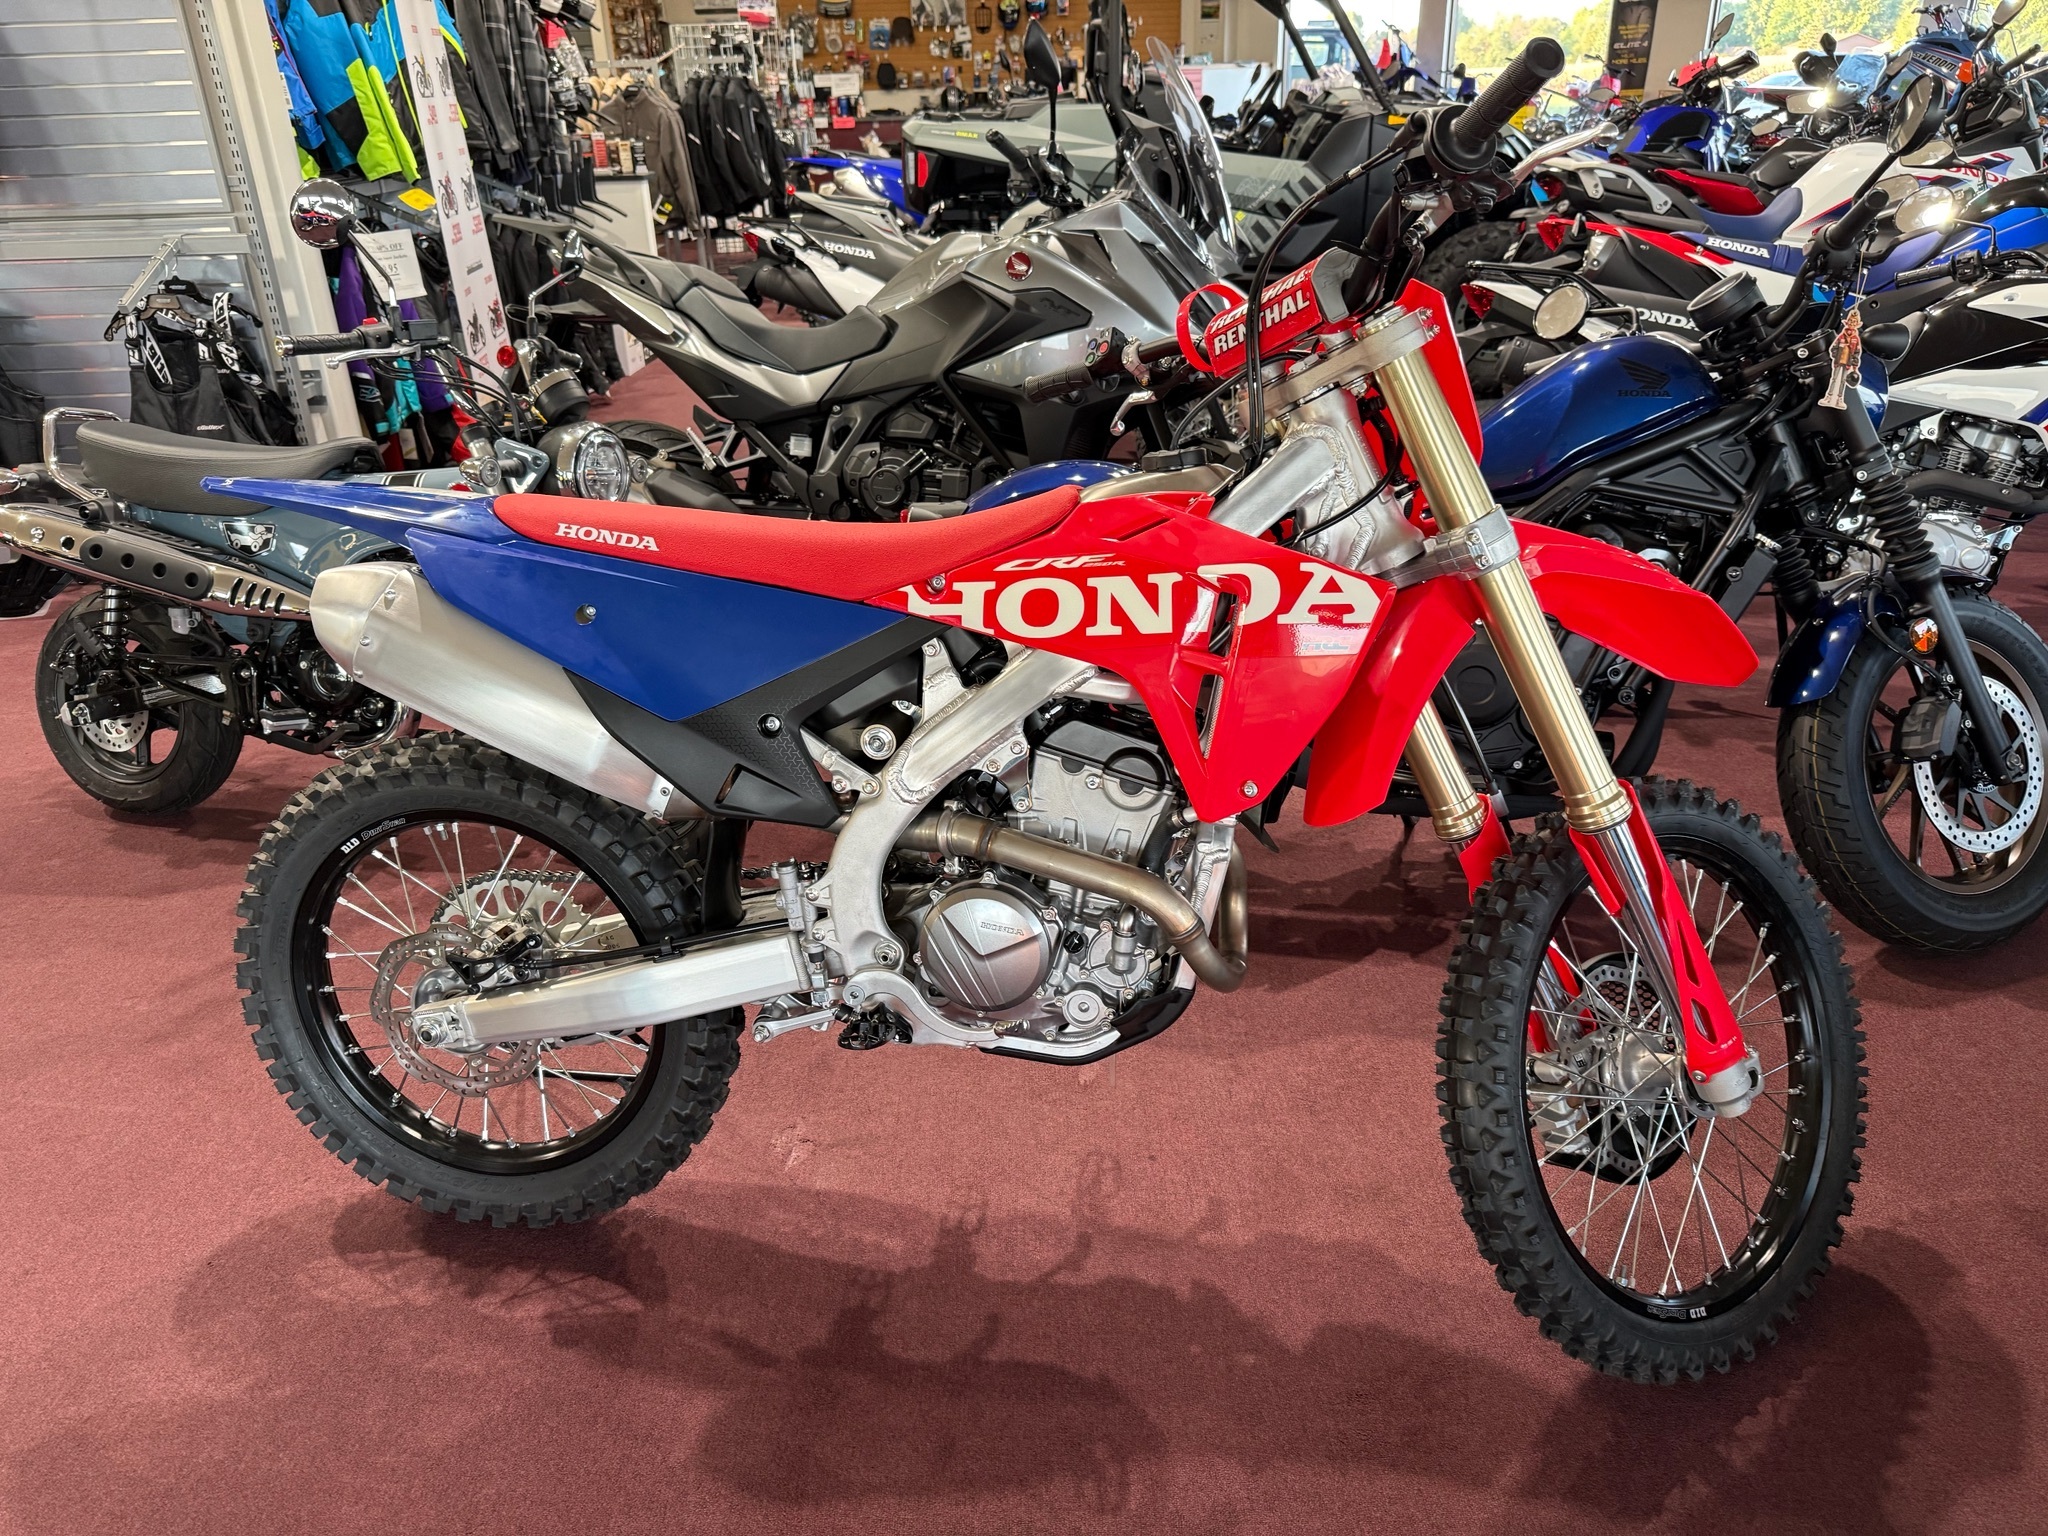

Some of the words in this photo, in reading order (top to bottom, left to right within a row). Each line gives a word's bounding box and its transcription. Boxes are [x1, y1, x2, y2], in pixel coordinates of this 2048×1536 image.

[823, 240, 877, 260] HONDA
[1705, 236, 1770, 259] HONDA
[1617, 389, 1673, 398] HONDA
[555, 523, 660, 551] HONDA
[993, 553, 1117, 572] CRF
[1081, 560, 1126, 568] 250R
[906, 562, 1381, 639] HONDA
[980, 921, 1025, 936] HONDA
